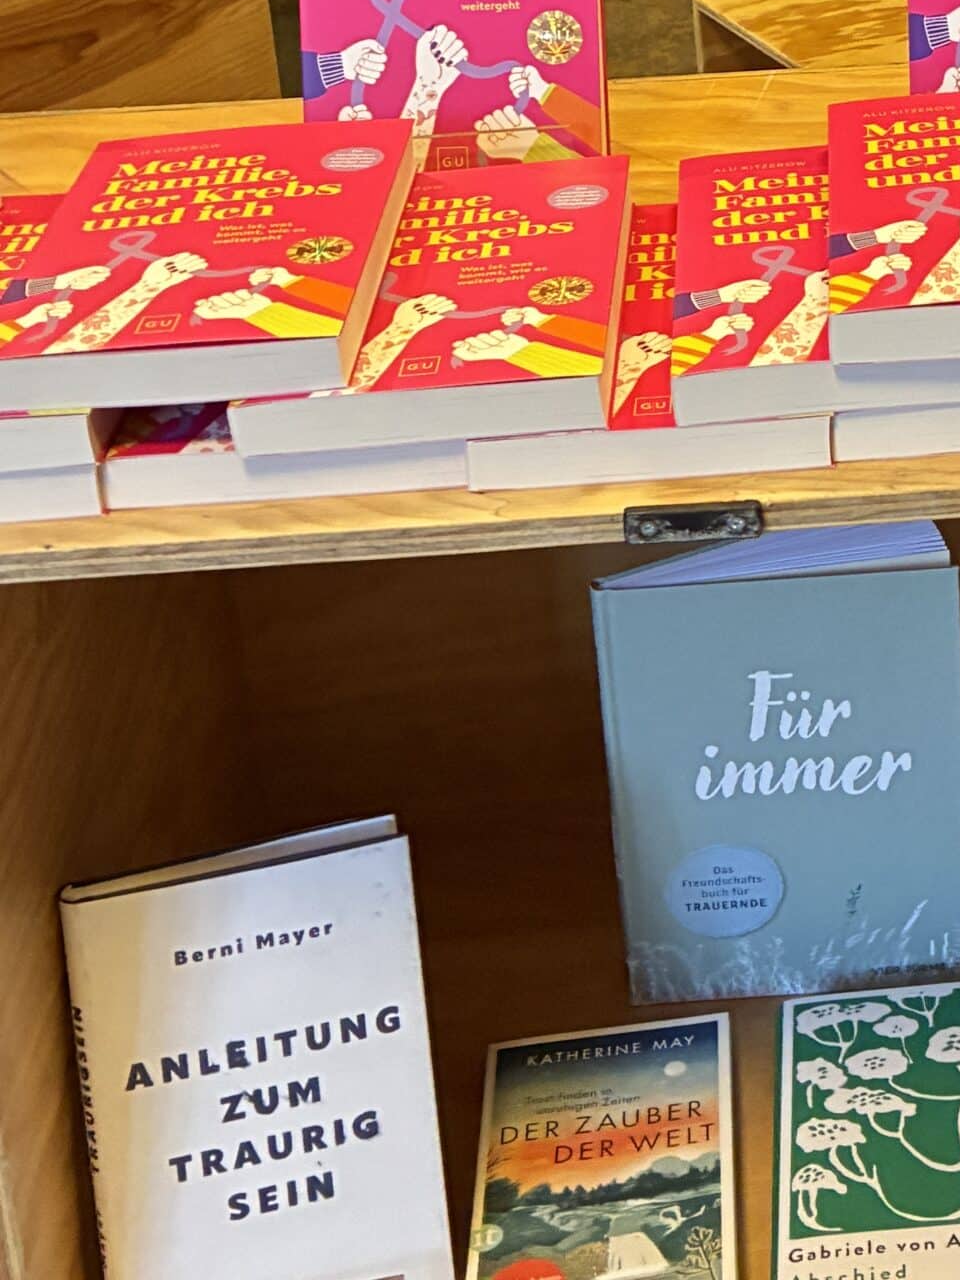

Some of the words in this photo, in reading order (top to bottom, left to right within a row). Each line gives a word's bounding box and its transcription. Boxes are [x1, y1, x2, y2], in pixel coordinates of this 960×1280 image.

[460, 0, 520, 13] weitergeht
[114, 154, 267, 178] Meine
[441, 154, 466, 168] GU
[864, 152, 948, 172] der
[713, 173, 829, 194] Mein
[91, 193, 182, 214] der
[191, 181, 341, 205] Krebs
[405, 194, 493, 213] ine
[713, 191, 829, 211] Fami
[81, 207, 186, 232] und
[195, 201, 275, 222] ich
[712, 209, 796, 228] der
[427, 221, 576, 246] Krebs
[712, 223, 810, 247] und
[433, 242, 512, 265] ich
[145, 318, 174, 329] GU
[407, 361, 435, 372] GU
[747, 670, 852, 741] Für
[695, 745, 912, 801] immer
[682, 875, 767, 888] Freundschafts-
[713, 865, 735, 875] Das
[701, 888, 729, 898] buch
[732, 886, 750, 897] für
[685, 898, 768, 912] TRAUERNDE
[174, 938, 244, 966] Berni
[255, 923, 333, 952] Mayer
[125, 1005, 401, 1092] ANLEITUNG
[527, 1042, 641, 1067] KATHERINE
[652, 1035, 695, 1050] MAY
[220, 1076, 321, 1123] ZUM
[500, 1120, 559, 1145] DER
[575, 1100, 702, 1135] ZAUBER
[169, 1110, 380, 1183] TRAURIG
[554, 1139, 614, 1164] DER
[629, 1123, 715, 1153] WELT
[227, 1171, 335, 1221] SEIN
[788, 1240, 886, 1263] Gabriele
[897, 1239, 935, 1252] von
